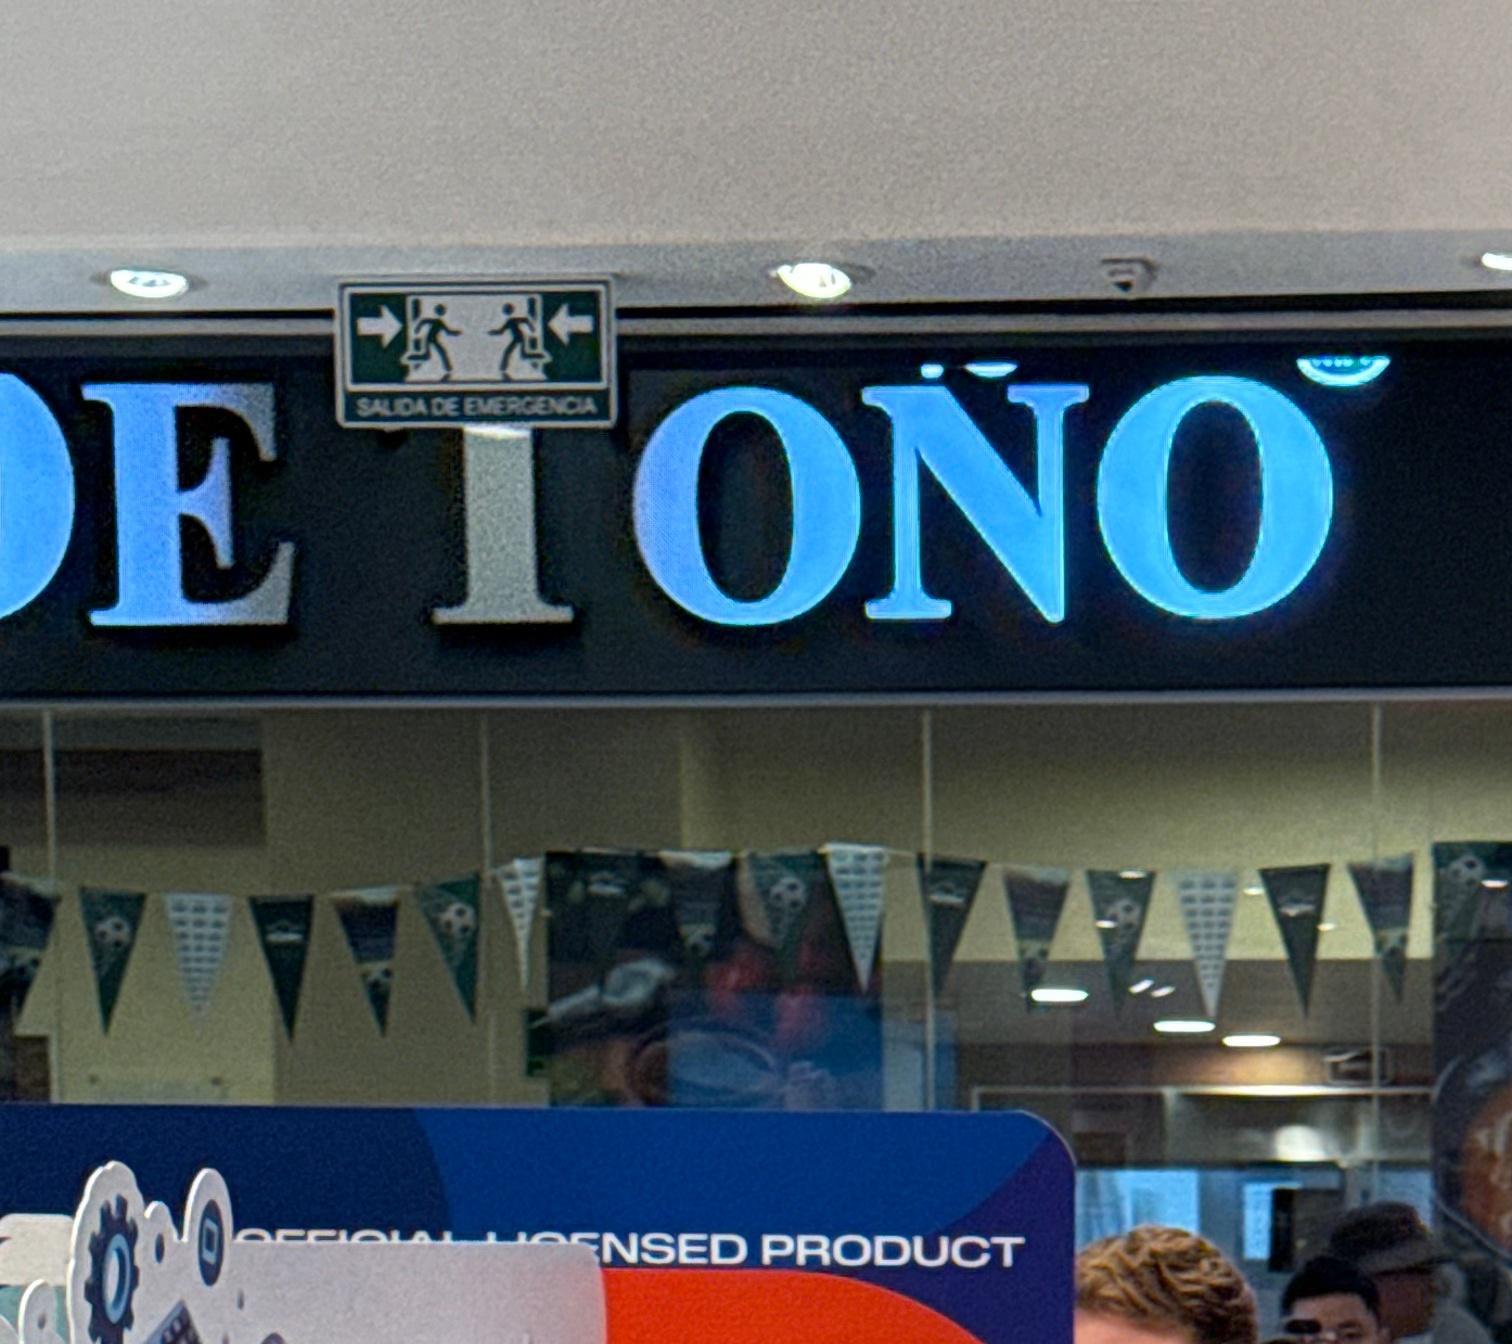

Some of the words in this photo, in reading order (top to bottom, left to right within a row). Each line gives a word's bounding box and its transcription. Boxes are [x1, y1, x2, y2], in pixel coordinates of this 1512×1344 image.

[356, 397, 428, 417] SALIDA
[430, 397, 460, 417] DE
[463, 396, 599, 417] EMERGENCIA
[761, 1234, 1026, 1269] PRODUCT
